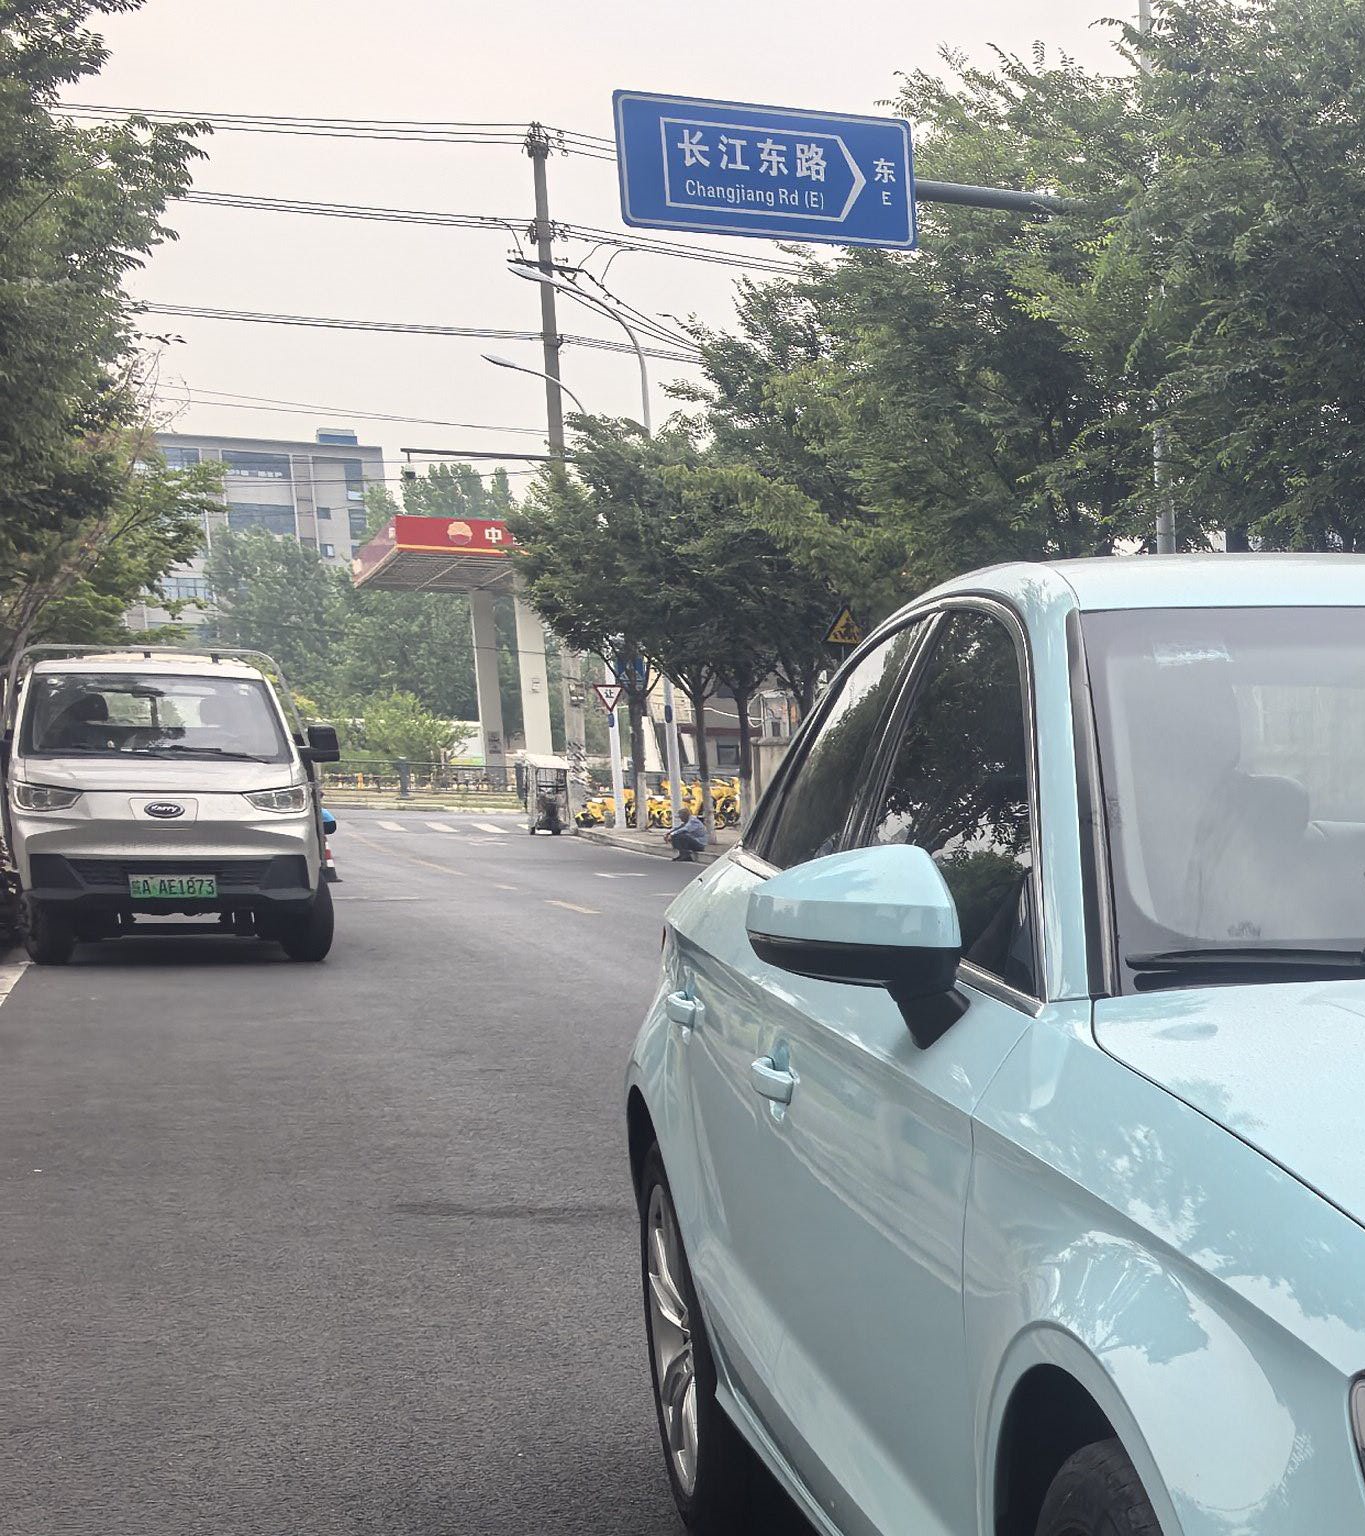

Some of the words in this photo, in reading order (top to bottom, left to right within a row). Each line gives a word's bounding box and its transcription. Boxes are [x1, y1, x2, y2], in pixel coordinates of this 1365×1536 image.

[677, 129, 827, 182] 长江东路
[873, 157, 896, 183] 东
[685, 179, 775, 207] Changjiang
[778, 188, 799, 206] Rd
[804, 191, 824, 210] (E)
[882, 190, 892, 206] E
[604, 688, 614, 699] 让
